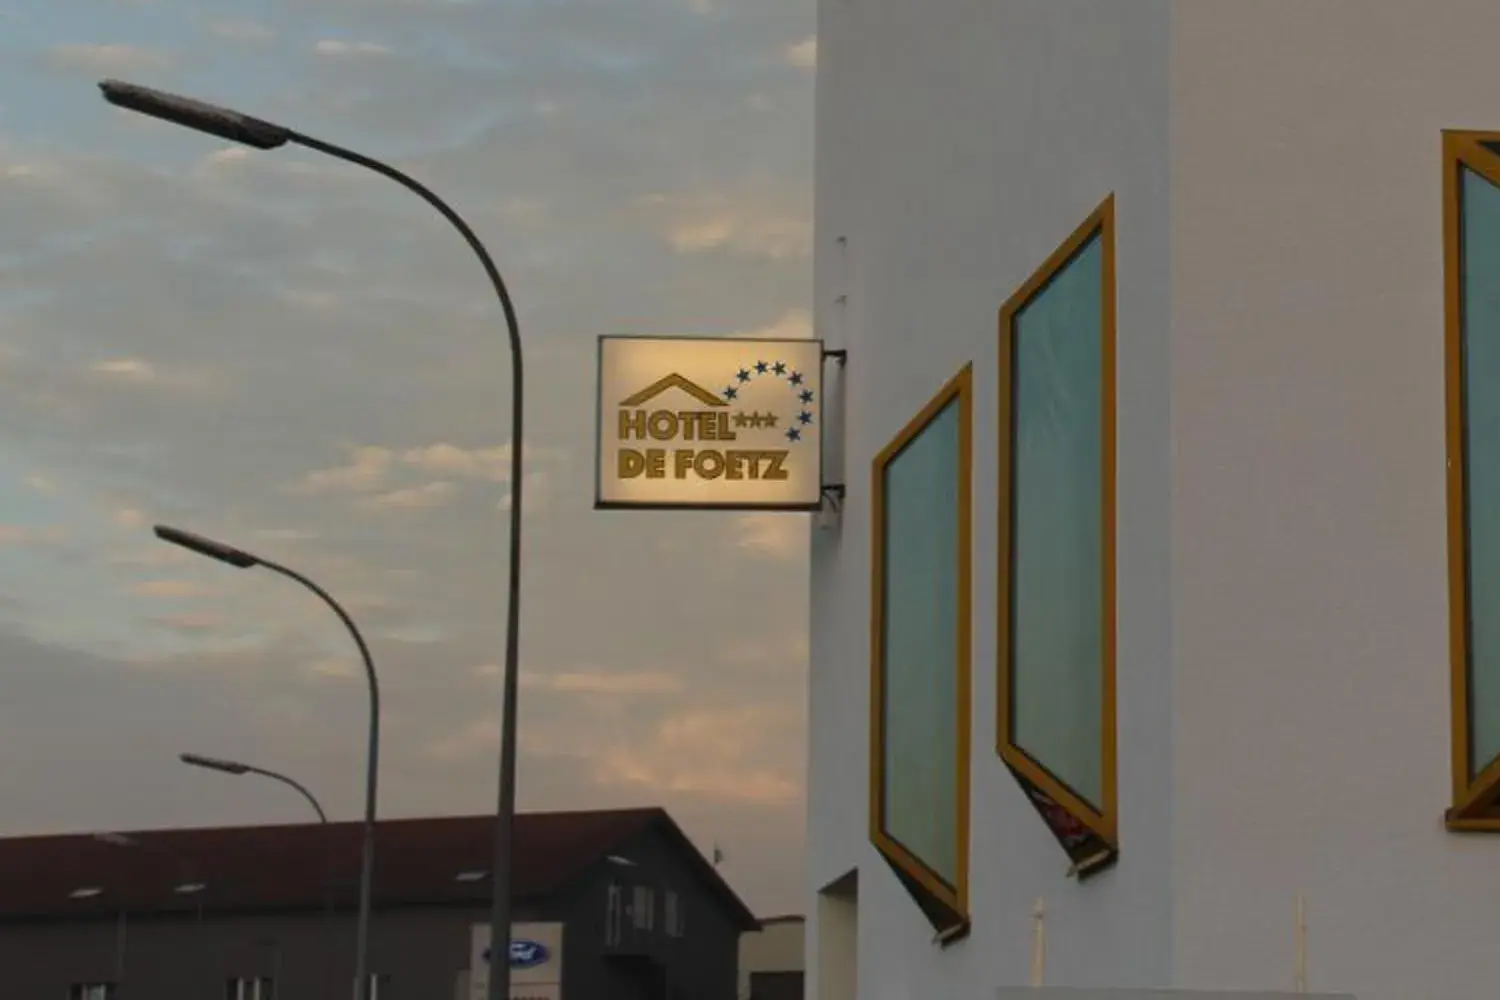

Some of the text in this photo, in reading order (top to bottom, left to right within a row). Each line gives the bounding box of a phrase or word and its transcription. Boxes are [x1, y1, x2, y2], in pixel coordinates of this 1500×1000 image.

[617, 409, 736, 441] HOTEL
[617, 448, 789, 480] DE FOETZ
